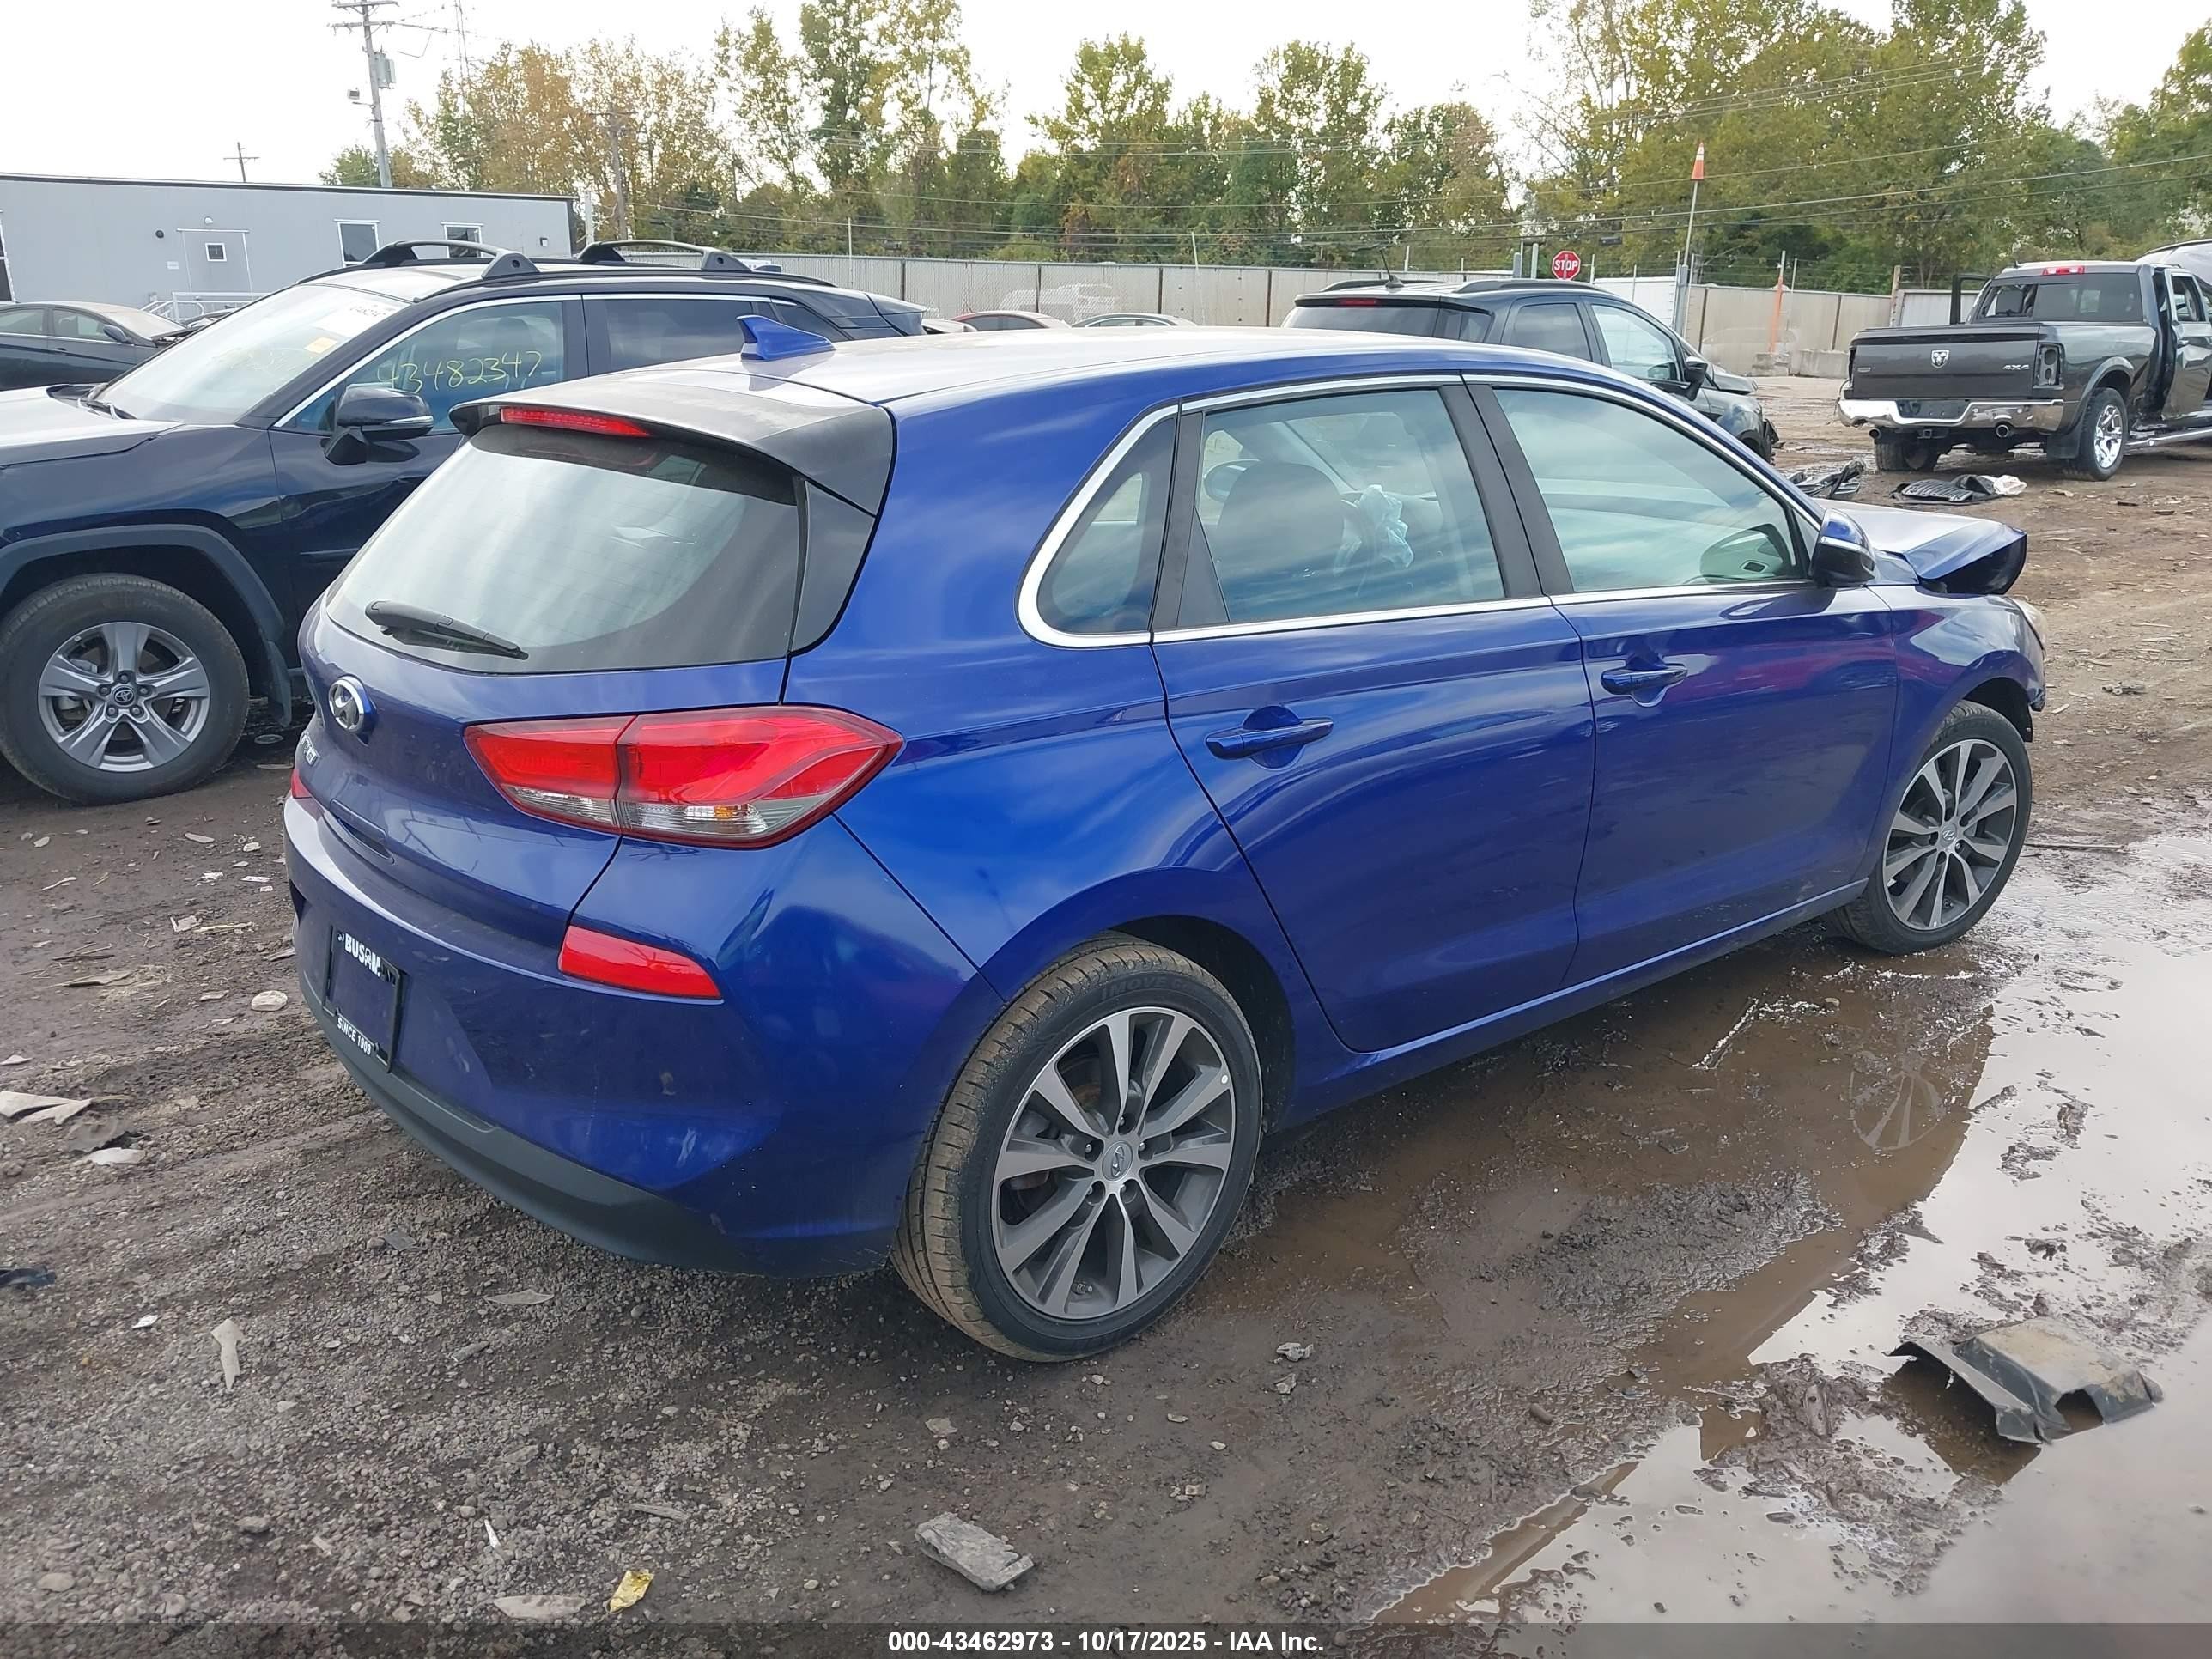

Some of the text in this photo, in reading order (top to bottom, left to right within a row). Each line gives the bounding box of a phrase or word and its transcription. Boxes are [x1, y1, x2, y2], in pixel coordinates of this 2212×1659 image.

[1553, 260, 1578, 271] STOP
[377, 349, 543, 394] 43482347
[337, 1017, 372, 1056] SINCE 1909
